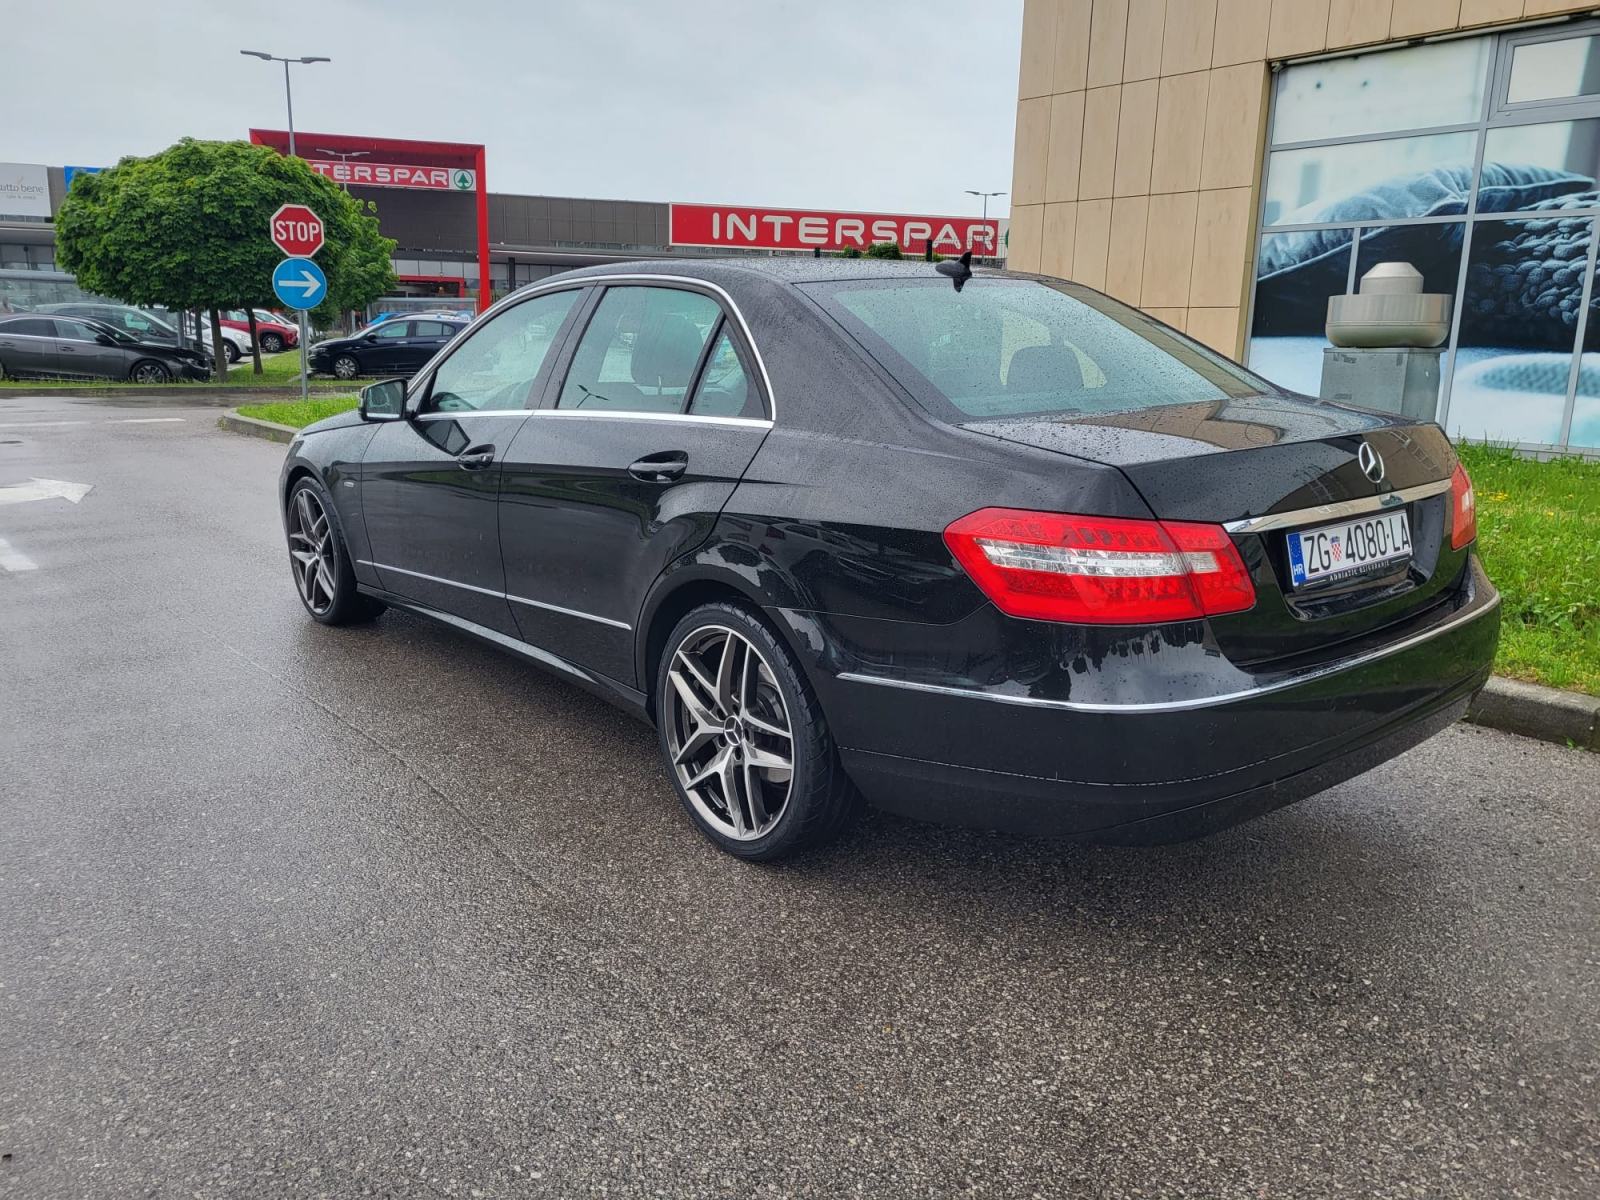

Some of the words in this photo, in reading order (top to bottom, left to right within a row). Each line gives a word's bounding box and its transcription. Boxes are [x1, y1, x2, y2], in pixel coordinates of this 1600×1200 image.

[313, 163, 448, 185] TERSPAR
[0, 184, 19, 192] utto
[21, 184, 44, 193] bene
[276, 220, 320, 243] STOP
[712, 212, 996, 251] INTERSPAR
[1303, 532, 1332, 574] ZG
[1293, 563, 1304, 575] HR
[1329, 570, 1358, 582] ADRIATIC
